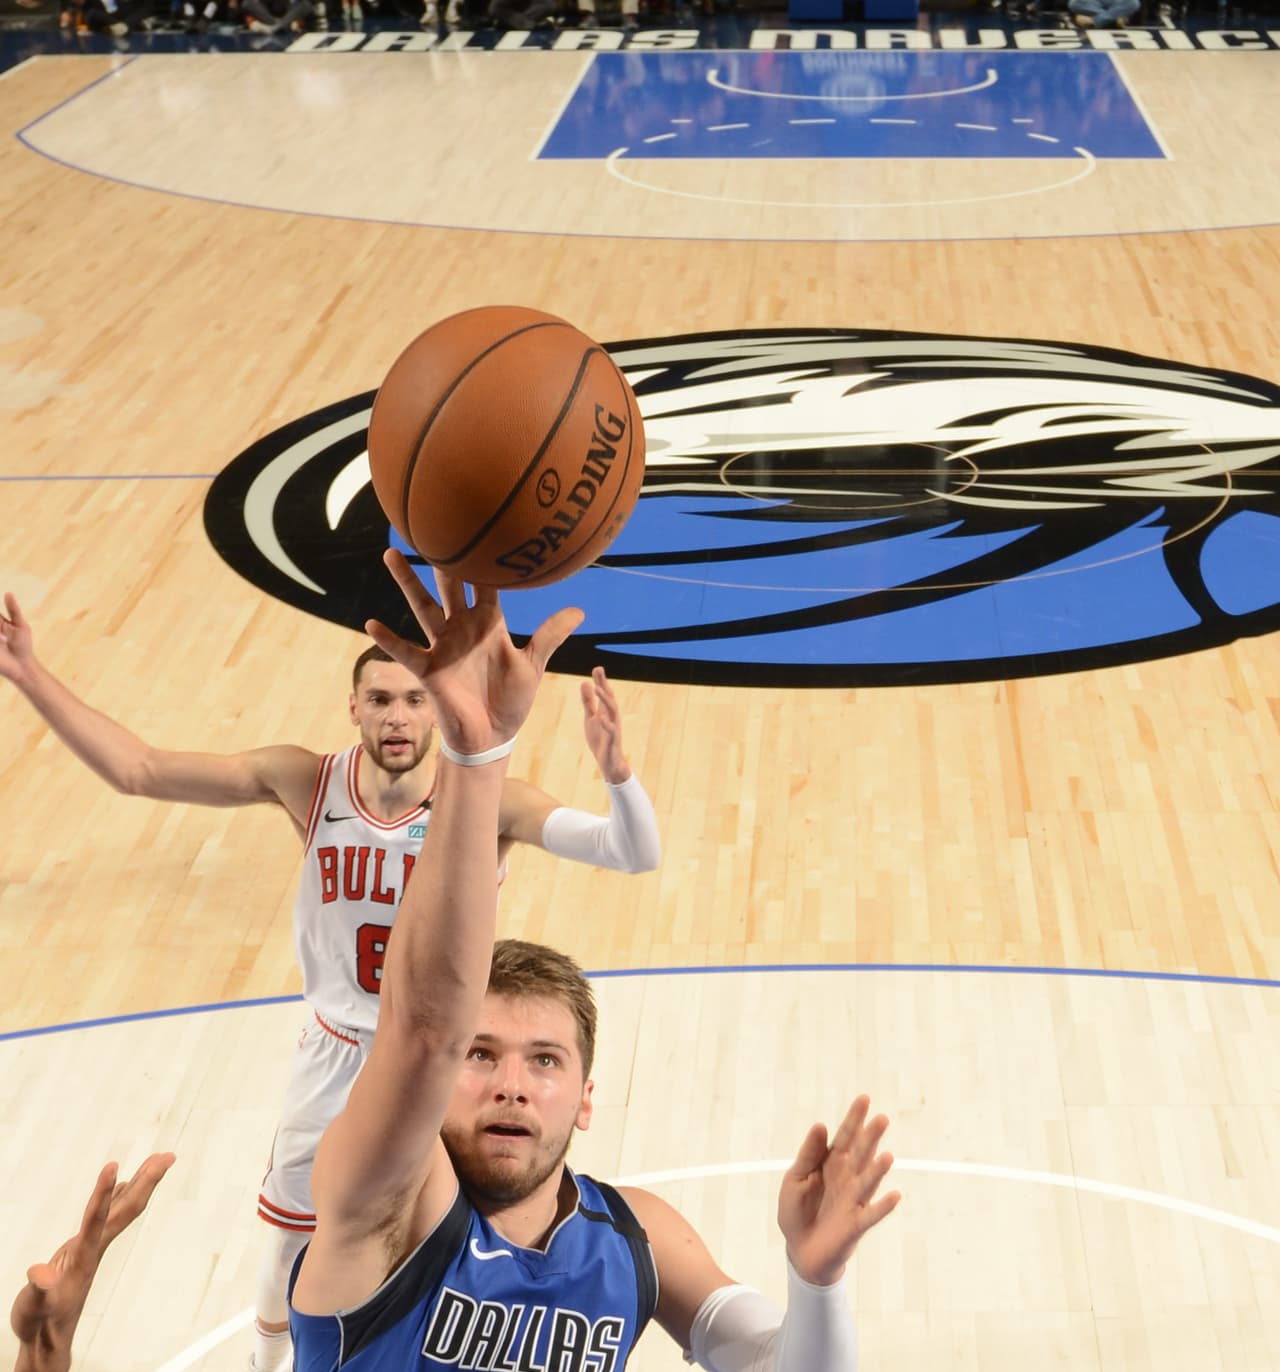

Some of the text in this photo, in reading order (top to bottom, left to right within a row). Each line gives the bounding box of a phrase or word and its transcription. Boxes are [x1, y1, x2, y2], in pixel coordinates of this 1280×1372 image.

[284, 29, 701, 53] DALLAS
[496, 403, 628, 579] SPALDING
[317, 846, 417, 905] BUL
